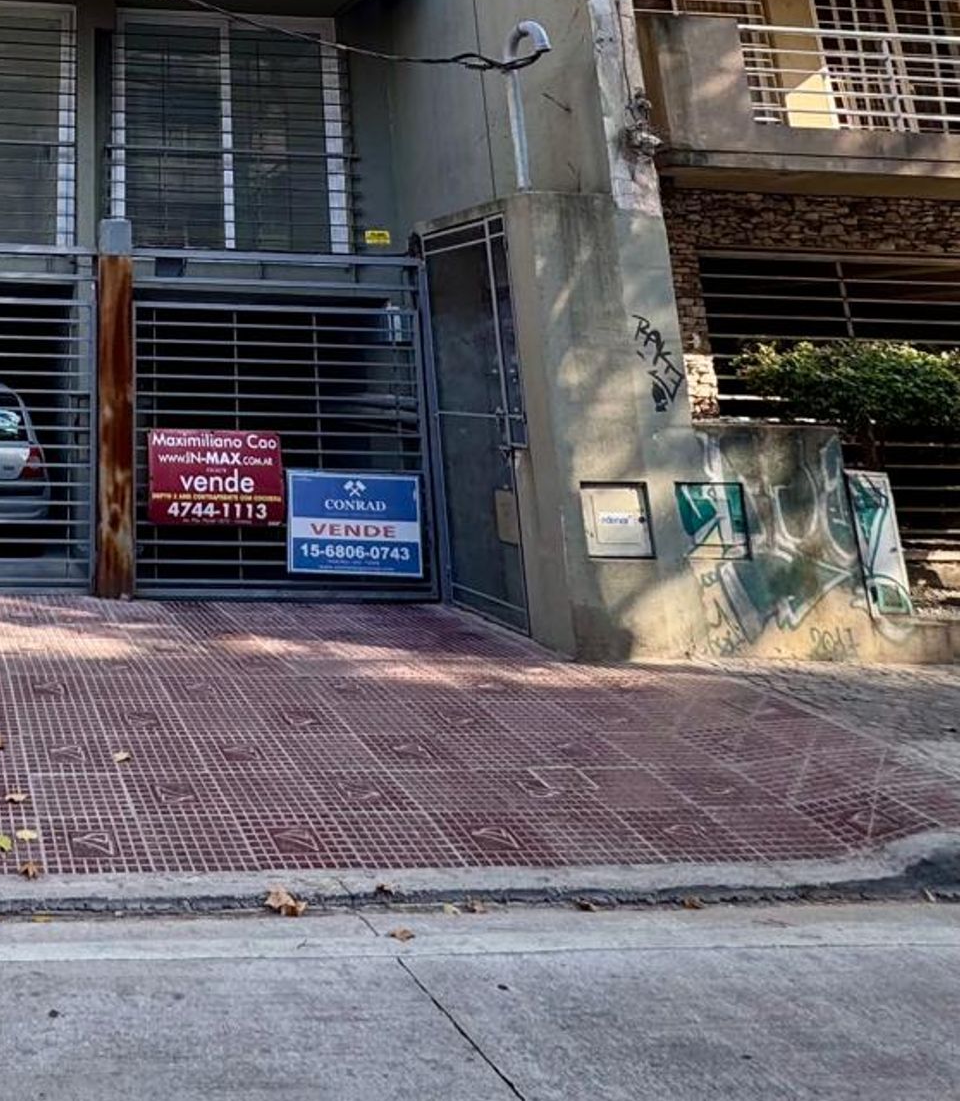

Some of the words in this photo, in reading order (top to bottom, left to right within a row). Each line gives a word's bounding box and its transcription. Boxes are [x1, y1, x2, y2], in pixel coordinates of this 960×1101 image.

[152, 432, 243, 448] Maximiliano
[246, 434, 278, 449] Cao
[180, 468, 255, 493] vende
[167, 502, 267, 519] 4744-1113
[324, 499, 387, 511] CONRAD
[310, 523, 396, 538] VENDE
[300, 543, 410, 560] 15-6806-0743
